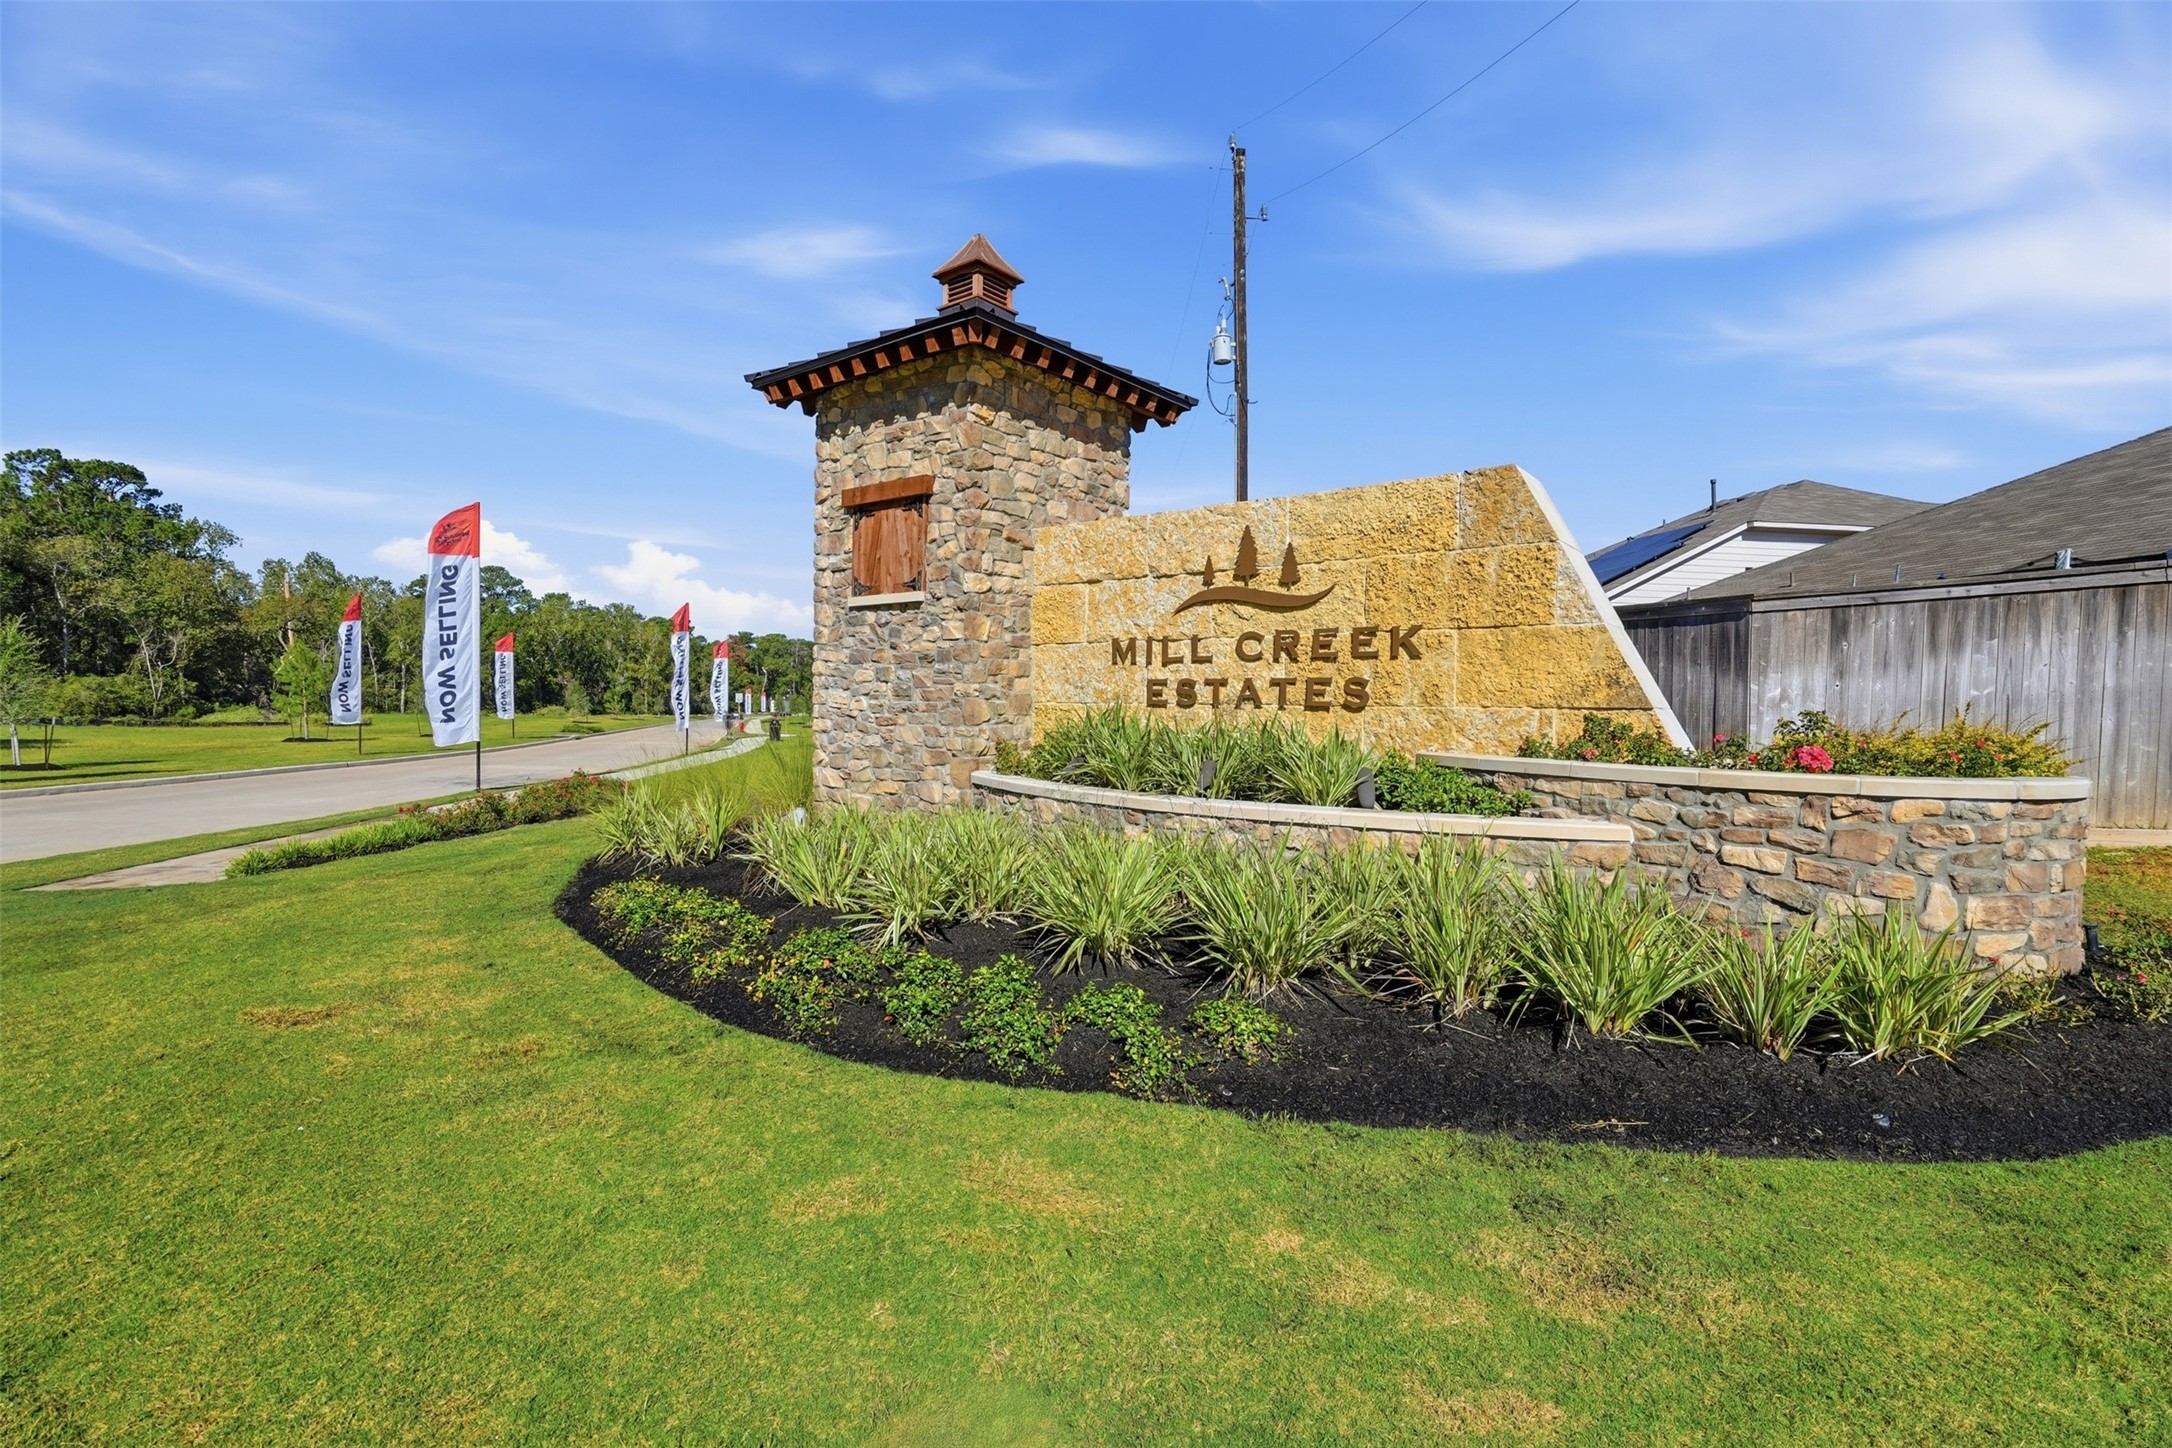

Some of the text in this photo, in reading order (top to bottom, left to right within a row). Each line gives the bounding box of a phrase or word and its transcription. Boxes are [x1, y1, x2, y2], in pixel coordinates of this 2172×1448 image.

[1111, 624, 1424, 667] MILL CREEK
[1146, 676, 1370, 713] ESTATES
